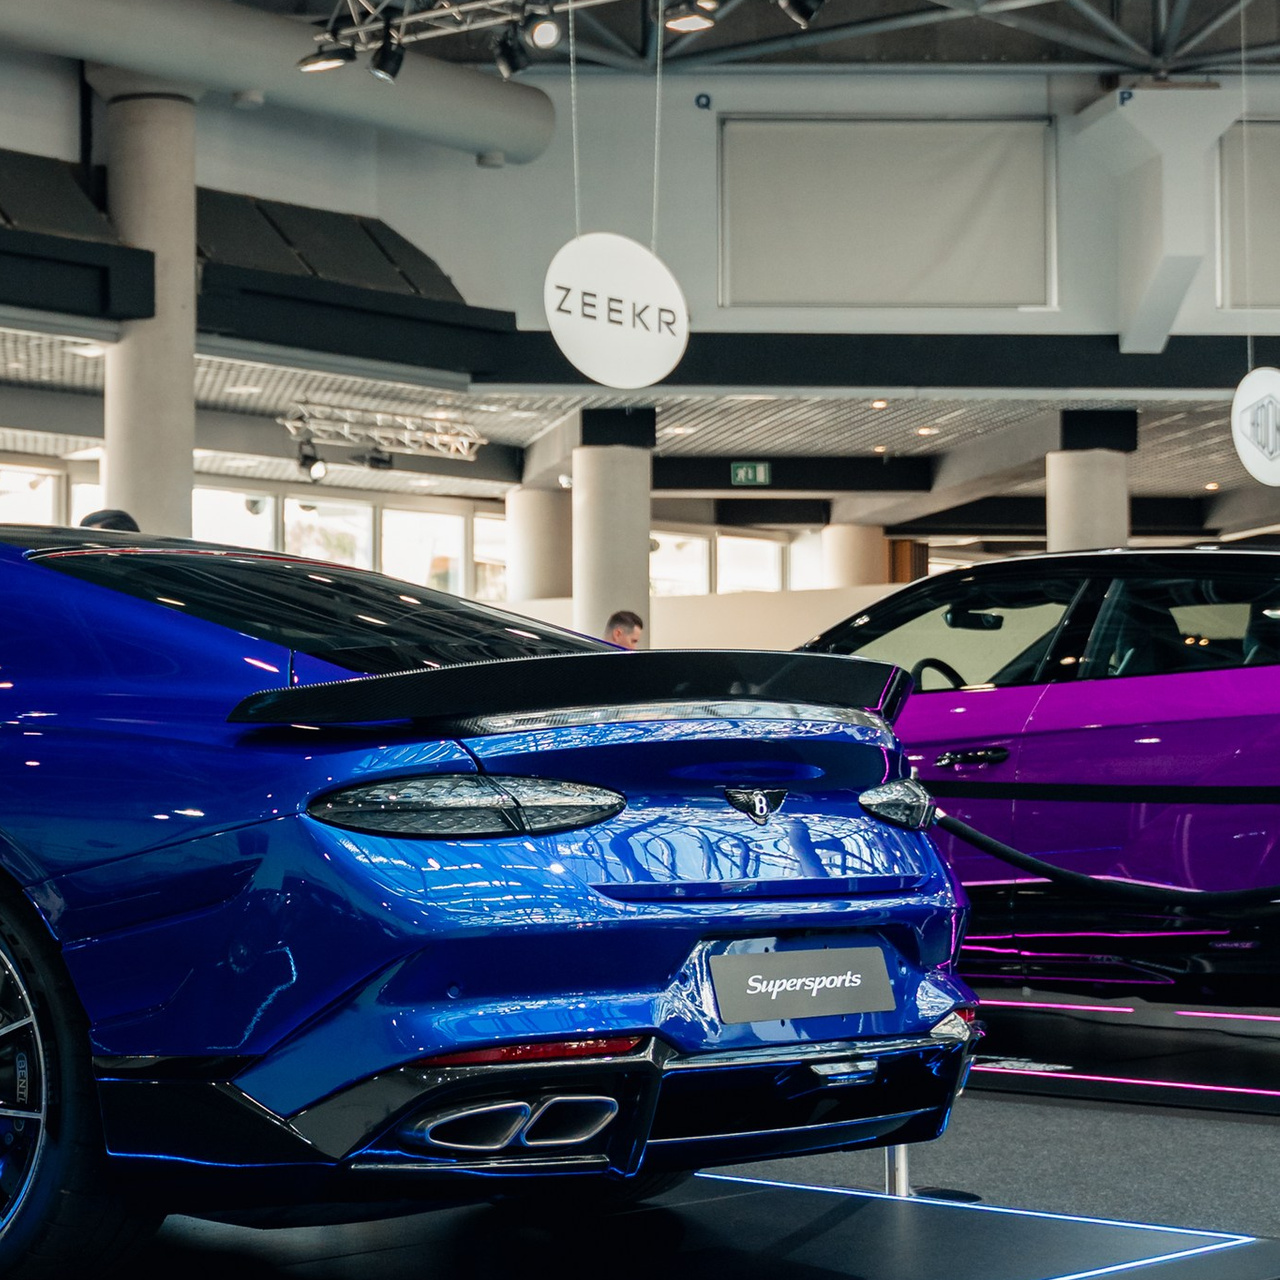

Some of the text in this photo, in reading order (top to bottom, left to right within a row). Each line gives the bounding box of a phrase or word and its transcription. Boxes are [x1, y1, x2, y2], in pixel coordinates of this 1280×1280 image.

[695, 93, 711, 111] Q
[1119, 90, 1133, 105] P
[554, 284, 677, 337] ZEEKR
[746, 970, 862, 1000] Supersports
